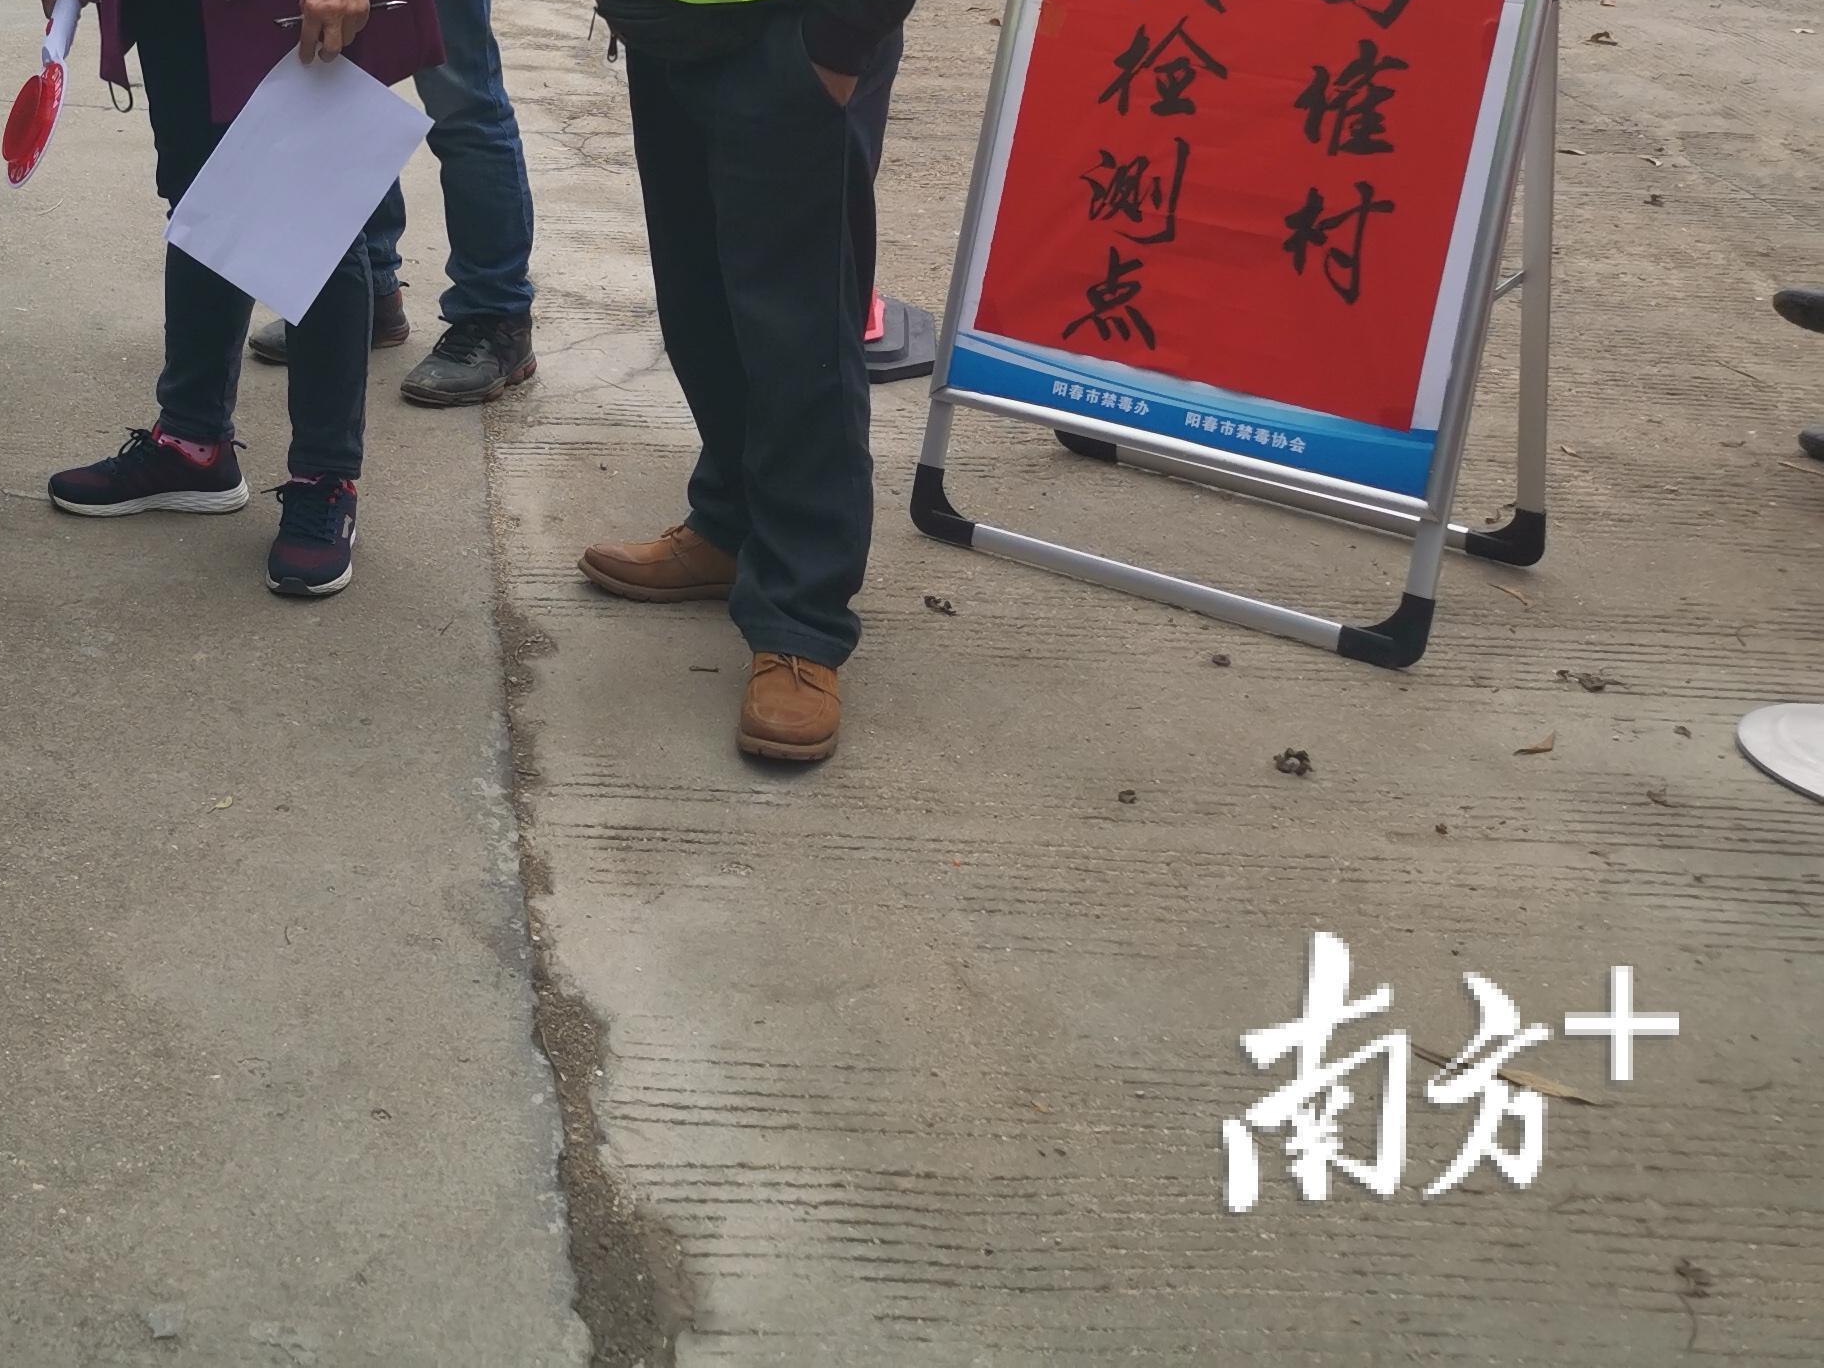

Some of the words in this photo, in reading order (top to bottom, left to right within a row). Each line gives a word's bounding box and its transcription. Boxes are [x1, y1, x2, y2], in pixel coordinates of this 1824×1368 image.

[1052, 381, 1150, 416] 阳春市禁毒办
[1185, 411, 1307, 454] 阳春市禁毒协会
